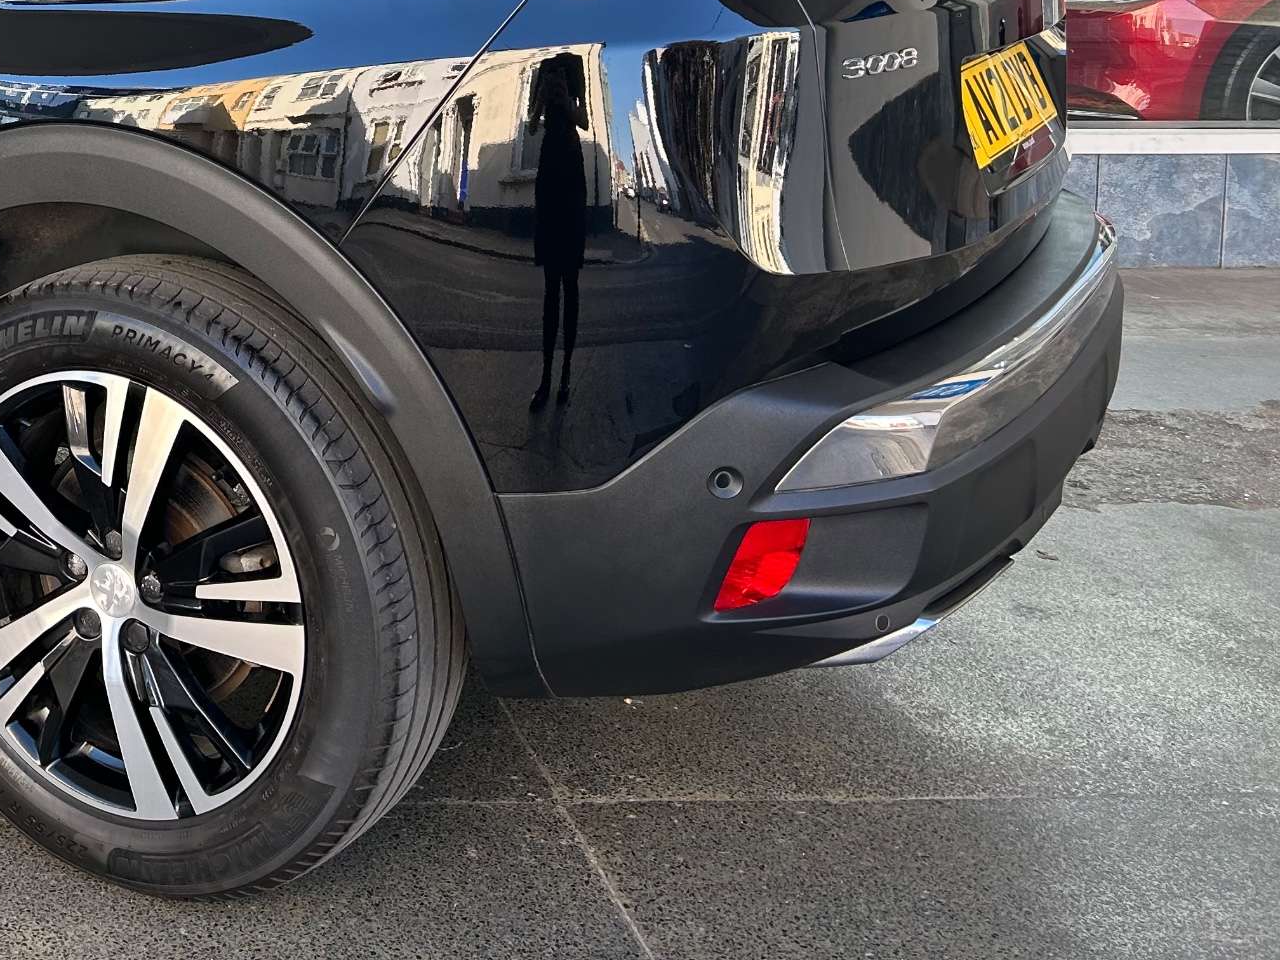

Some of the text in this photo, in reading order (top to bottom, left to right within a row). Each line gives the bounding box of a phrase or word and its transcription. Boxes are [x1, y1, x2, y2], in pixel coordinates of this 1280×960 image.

[842, 46, 918, 79] 3008
[112, 324, 204, 372] PRIMACY
[203, 370, 215, 383] 4
